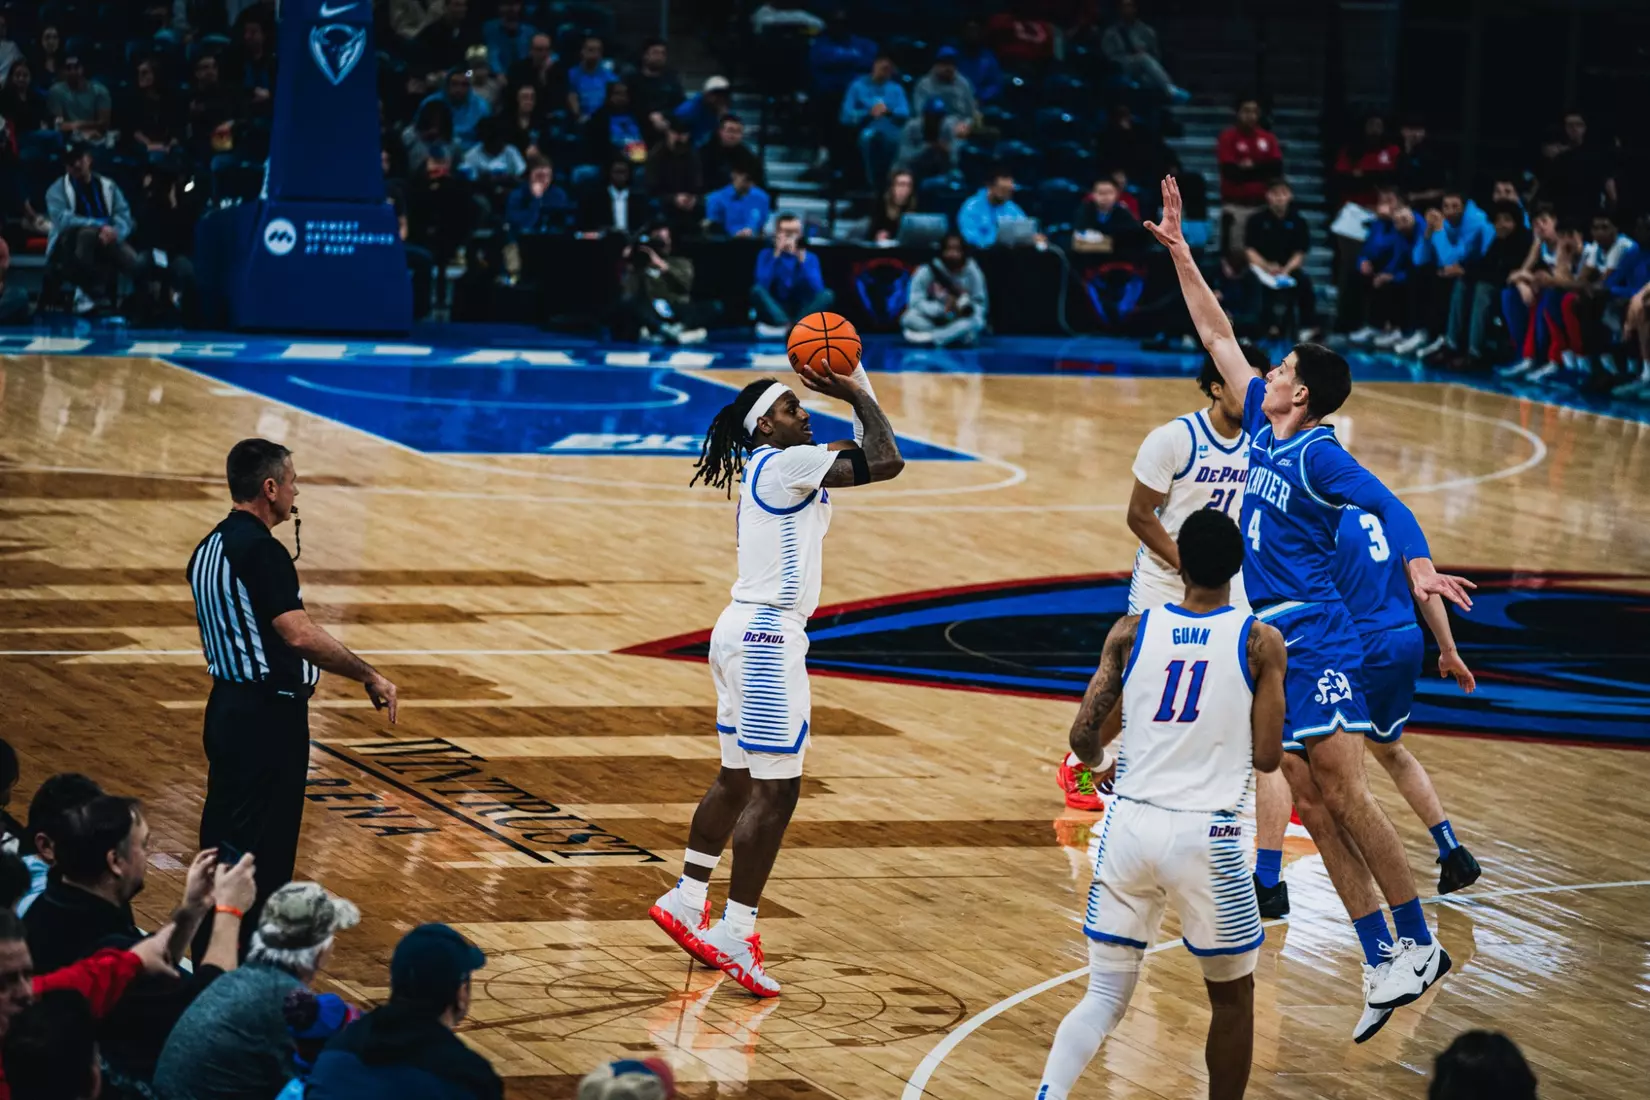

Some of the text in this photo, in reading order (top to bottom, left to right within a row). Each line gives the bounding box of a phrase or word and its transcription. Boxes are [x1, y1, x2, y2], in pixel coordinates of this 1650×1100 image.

[305, 221, 358, 231] MIDWEST
[1194, 466, 1248, 482] DEPAU
[1206, 489, 1236, 514] 21
[1248, 508, 1262, 552] 4
[1359, 513, 1390, 562] 3
[1172, 627, 1210, 645] GUNN
[1152, 660, 1208, 722] 11
[343, 737, 665, 863] WINTRUST
